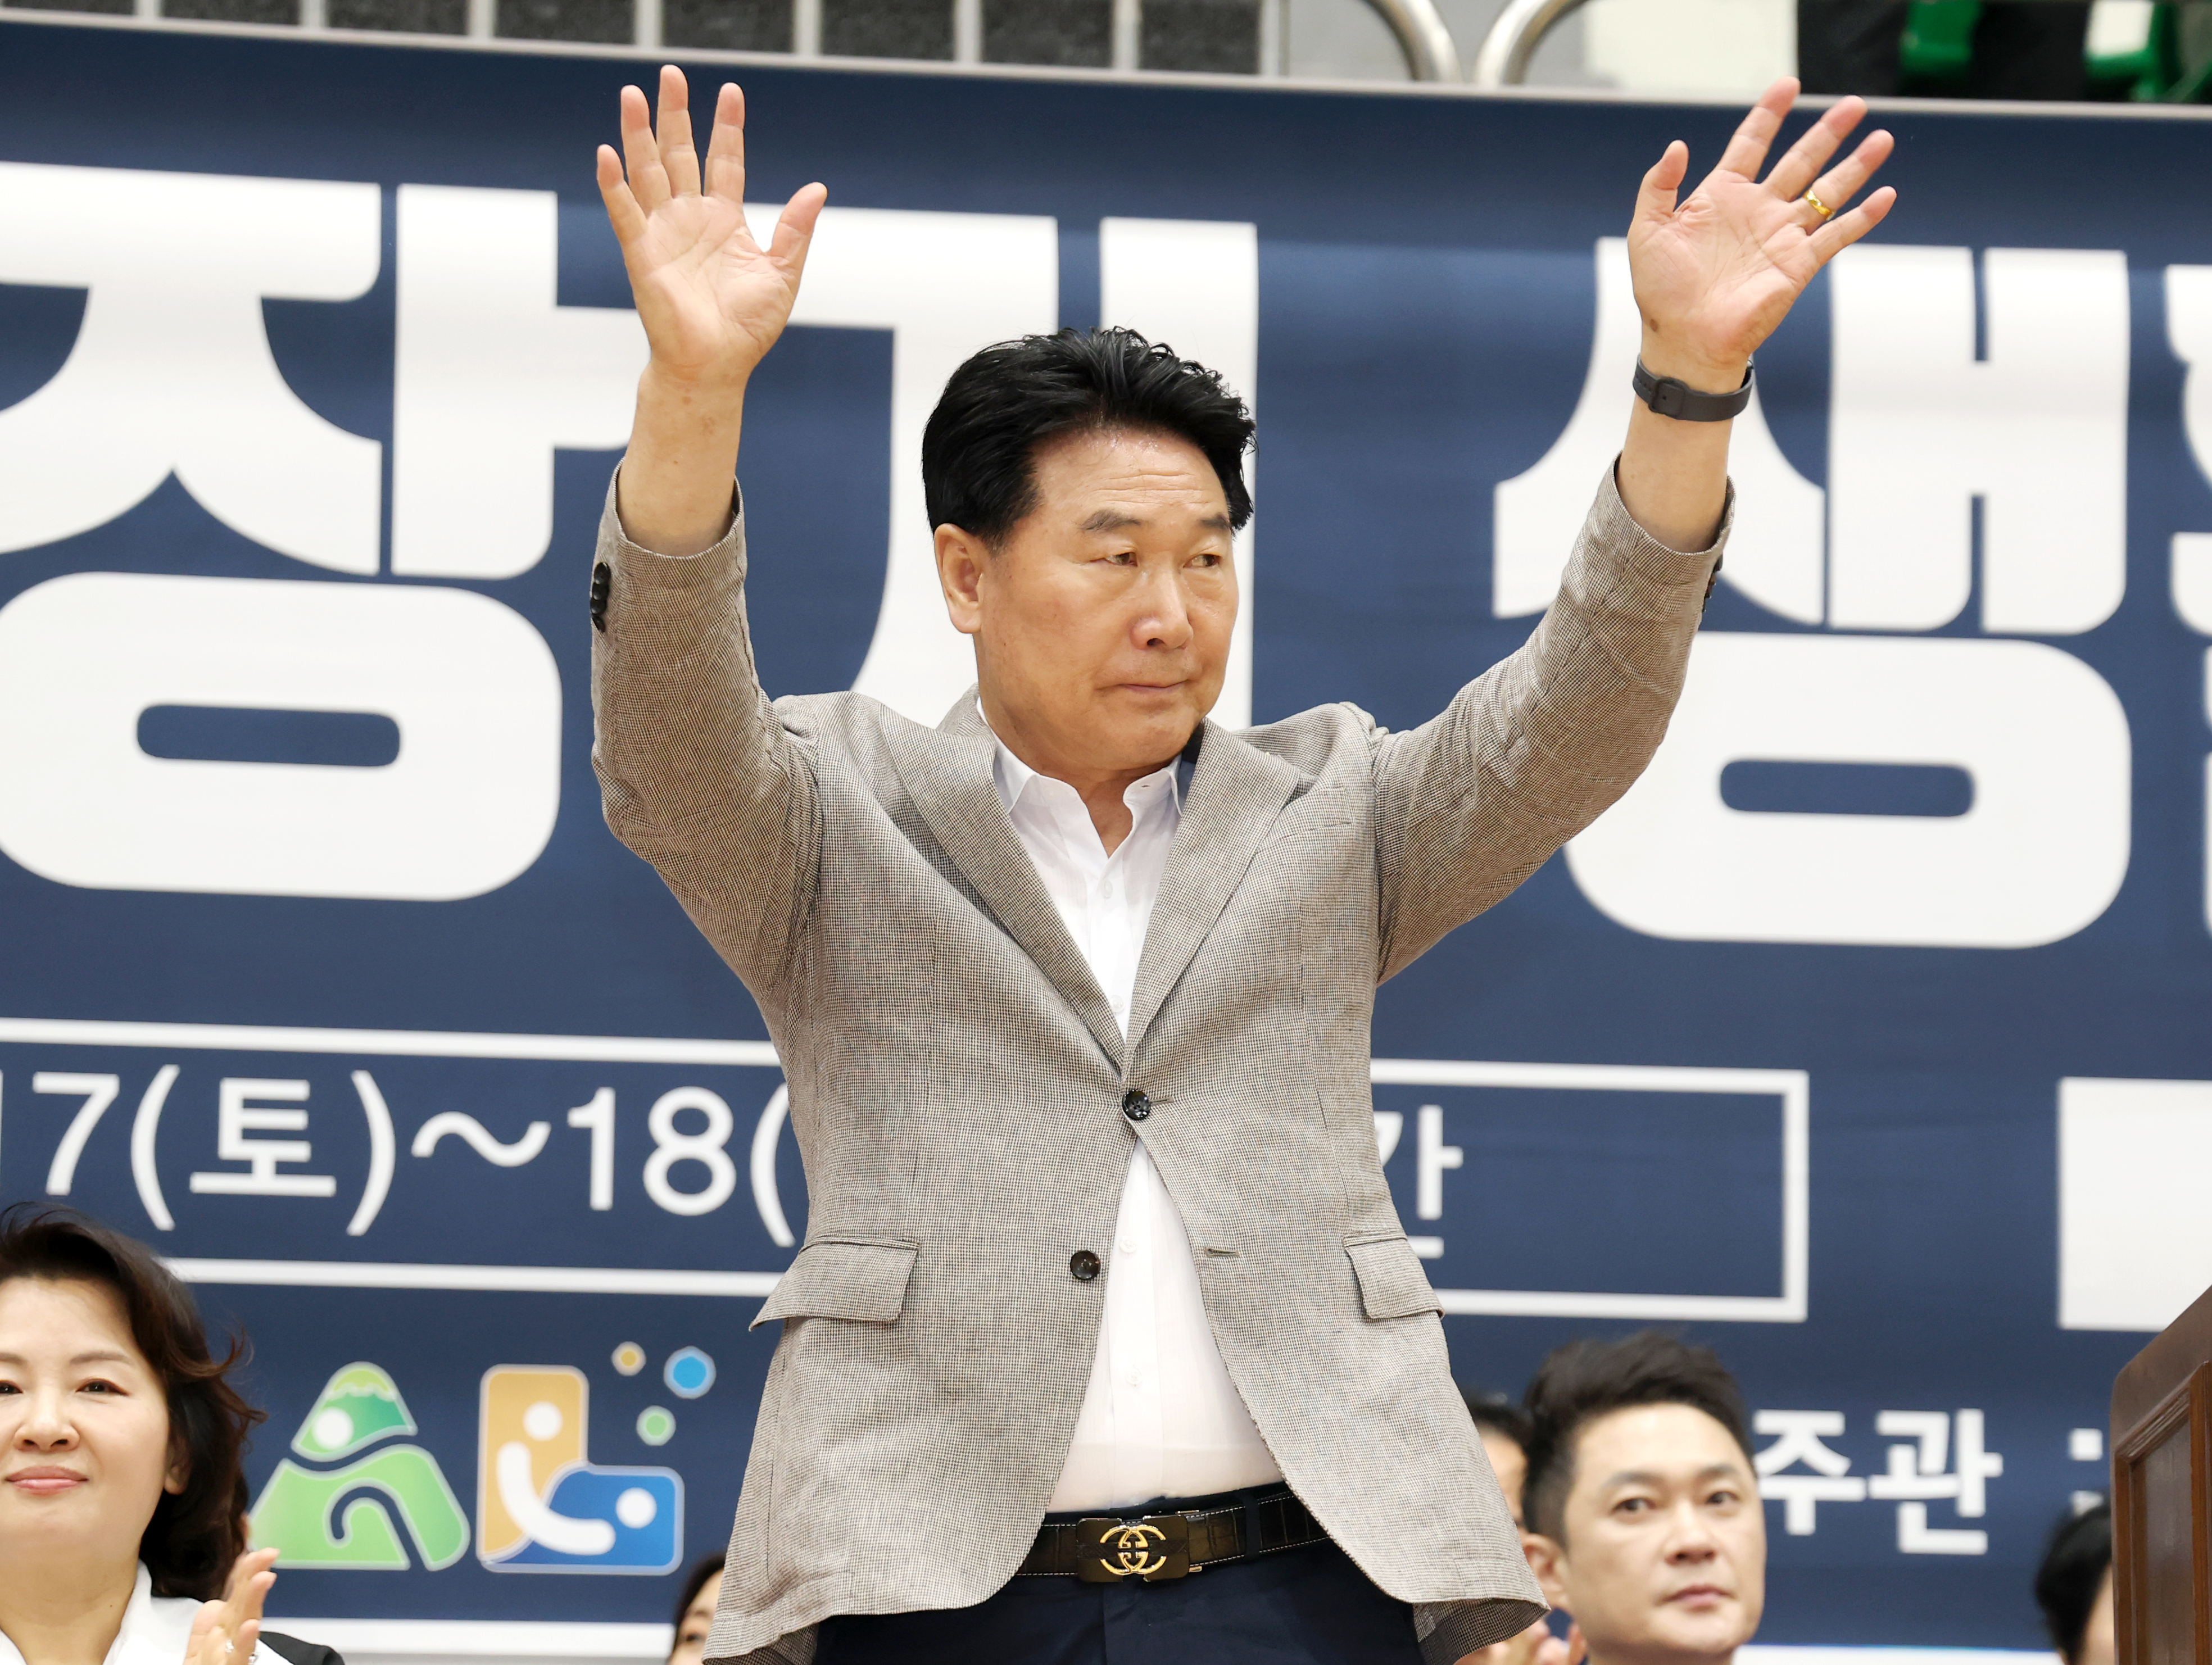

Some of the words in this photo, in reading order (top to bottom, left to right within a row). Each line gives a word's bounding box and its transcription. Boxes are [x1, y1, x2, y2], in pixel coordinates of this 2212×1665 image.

[1492, 236, 2212, 950] 생
[0, 1063, 796, 1247] 7(토)~18(
[1751, 1408, 2002, 1555] 주관
